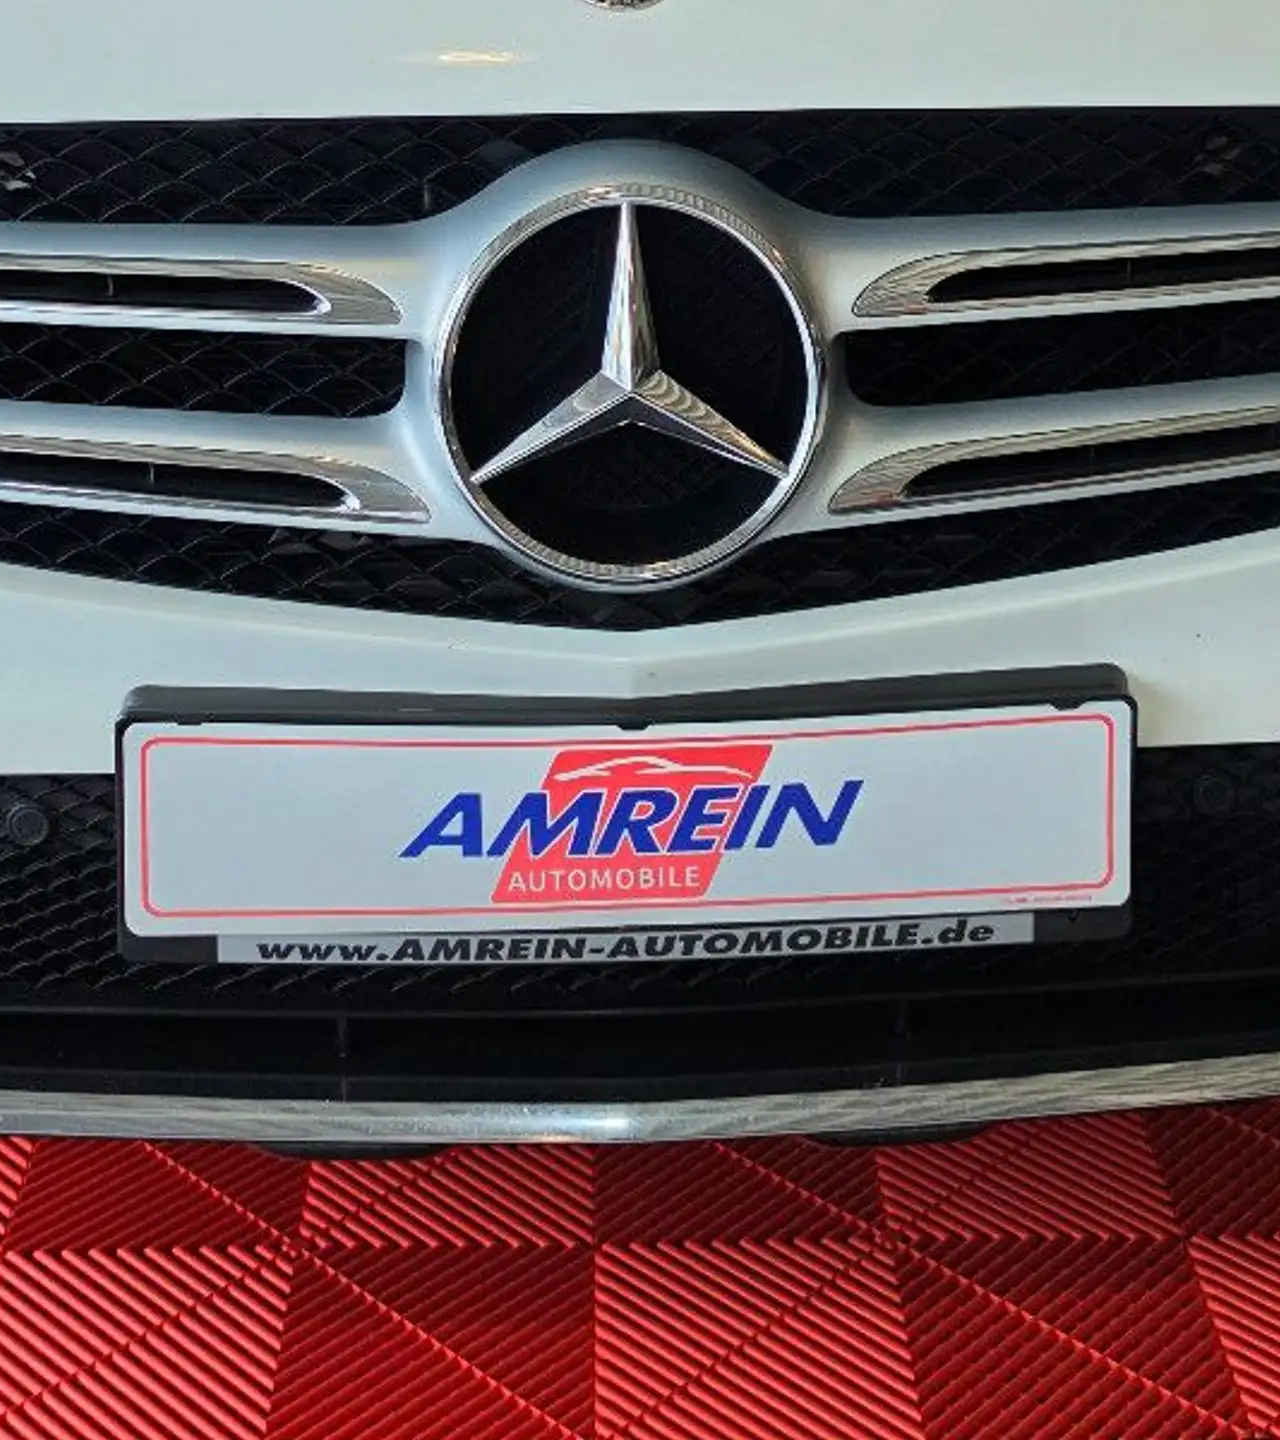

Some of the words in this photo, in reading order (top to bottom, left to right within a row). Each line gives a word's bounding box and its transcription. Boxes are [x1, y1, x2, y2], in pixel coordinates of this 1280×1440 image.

[398, 779, 865, 858] AMREIN
[508, 866, 702, 893] AUTOMOBILE
[256, 918, 995, 962] www.AMREIN-AUTOMOBILE.de
